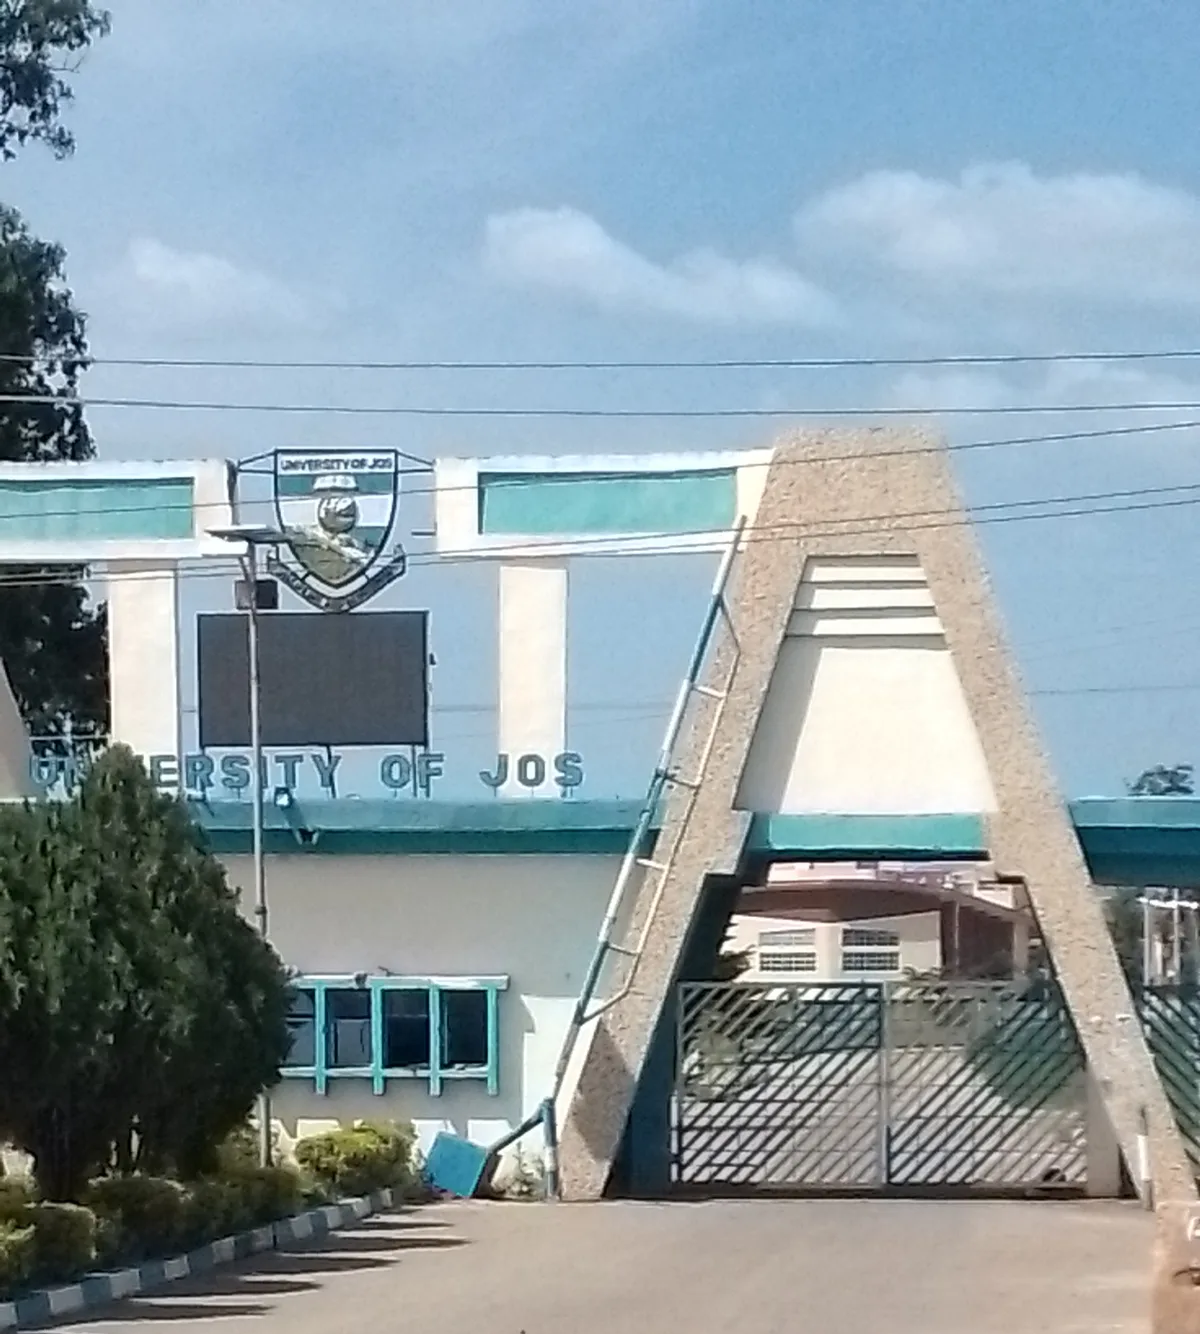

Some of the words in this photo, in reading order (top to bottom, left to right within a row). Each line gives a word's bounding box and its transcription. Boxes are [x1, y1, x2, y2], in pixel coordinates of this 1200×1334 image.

[30, 753, 342, 789] UERSITY
[380, 753, 444, 788] OF
[479, 753, 584, 788] JOS
